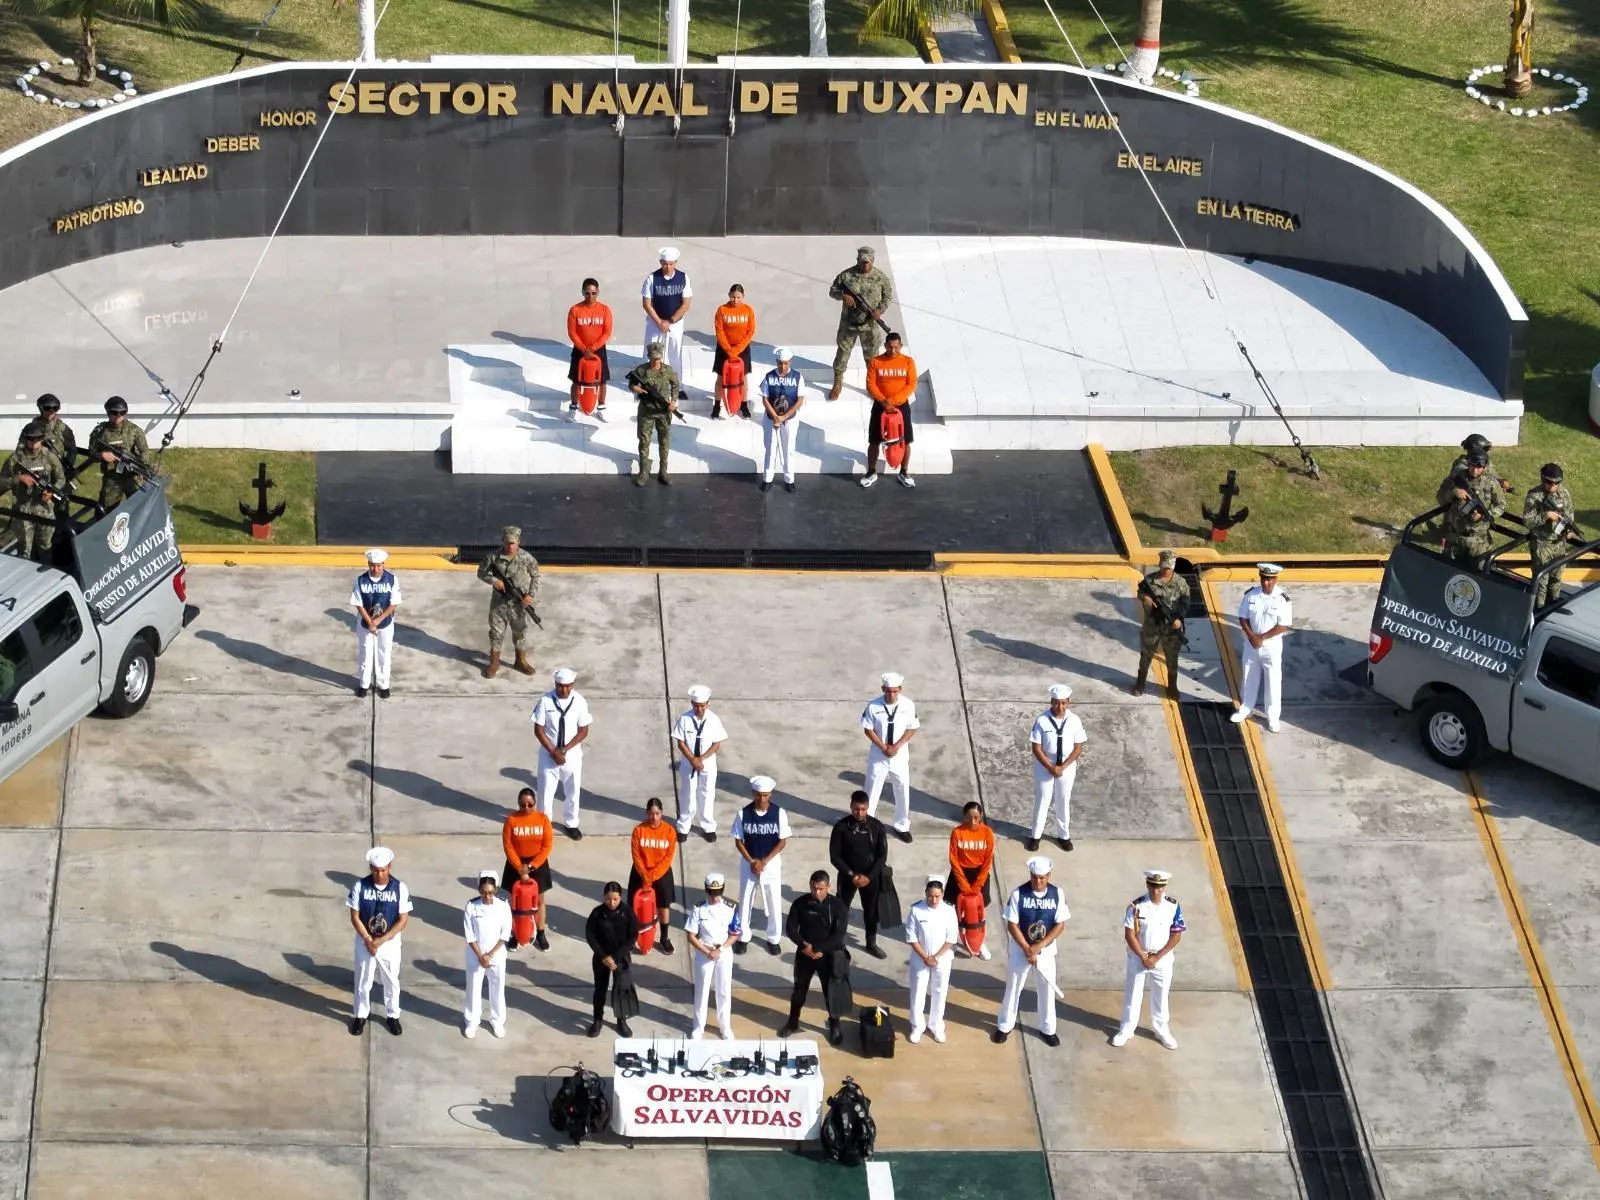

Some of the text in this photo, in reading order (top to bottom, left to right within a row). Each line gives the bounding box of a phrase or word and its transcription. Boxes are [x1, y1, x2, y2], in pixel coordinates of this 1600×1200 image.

[327, 81, 1028, 116] SECTOR NAVAL DE TUXPAN
[260, 111, 317, 127] HONOR
[1035, 110, 1120, 131] EN EL MAR
[207, 135, 260, 153] DEBER
[143, 164, 208, 187] LEALTAD
[1117, 153, 1202, 177] EN EL AIRE
[56, 199, 145, 234] PATRIOTISMO
[1197, 199, 1295, 233] EN LA TIERRA
[768, 377, 797, 387] MARINA
[878, 368, 907, 377] MARINA
[96, 547, 178, 614] PUESTO DE AUXILIO
[360, 583, 392, 594] MARINA
[1381, 616, 1508, 674] PUESTO DE AUXILIO
[1446, 619, 1526, 660] SALVAVIDAS
[743, 822, 779, 835] MARINA
[363, 889, 397, 903] MARINA
[1022, 897, 1057, 910] MARINA
[646, 1084, 792, 1104] OPERACIÓN
[634, 1106, 802, 1128] SALVAVIDAS
